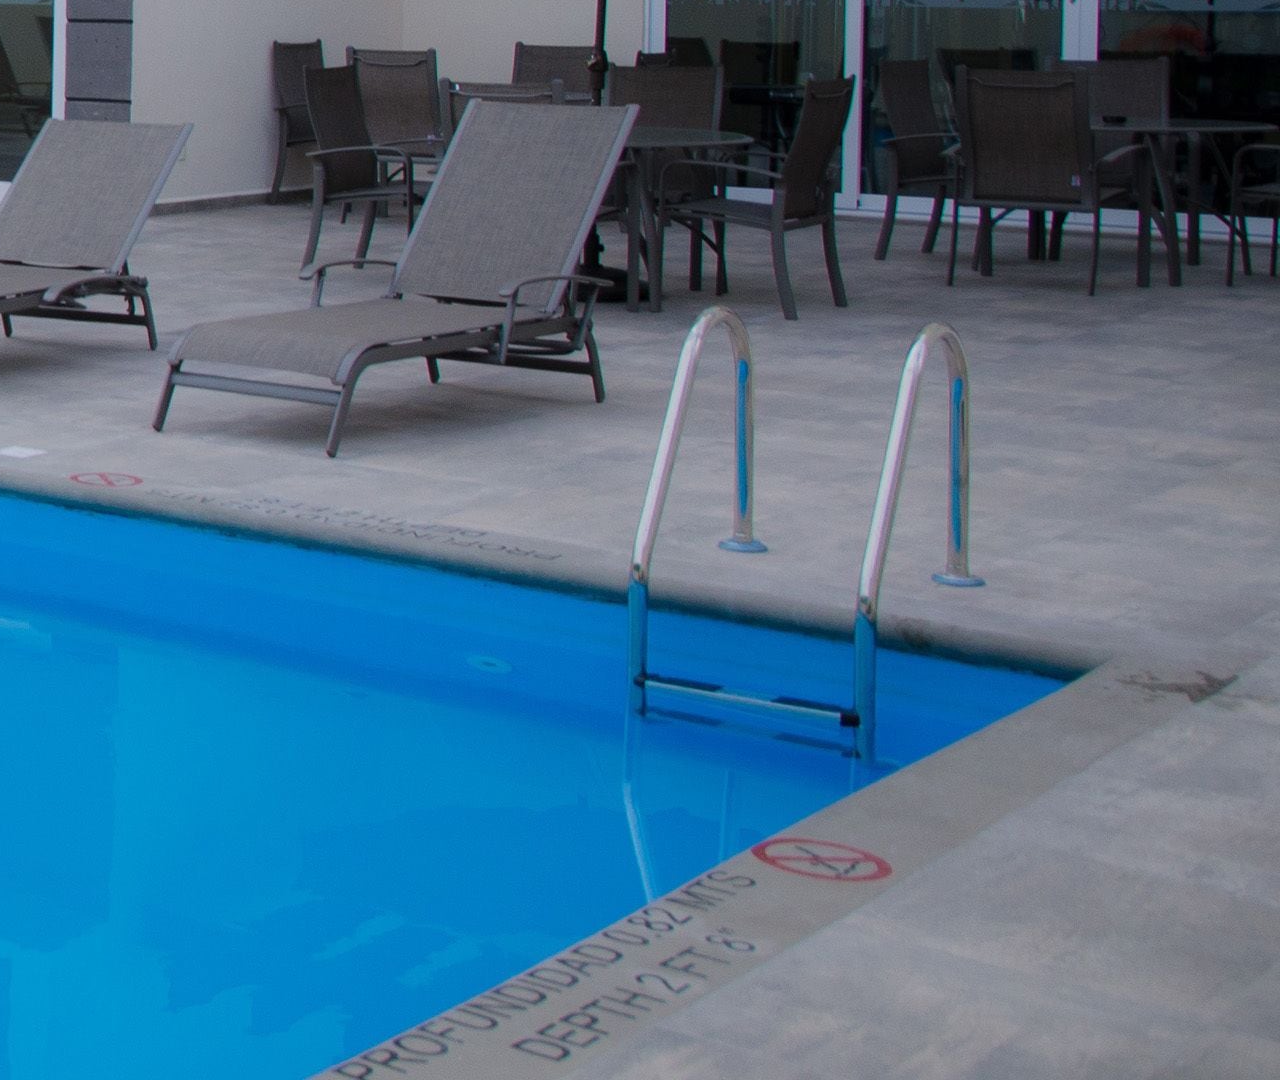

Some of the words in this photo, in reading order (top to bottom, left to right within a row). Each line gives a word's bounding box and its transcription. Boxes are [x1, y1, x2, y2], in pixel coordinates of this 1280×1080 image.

[334, 942, 624, 1080] PROFUNDIDAD
[602, 906, 694, 946] 0.82
[664, 870, 757, 912] MTS
[635, 973, 691, 994] 2
[658, 946, 733, 980] FT
[510, 986, 668, 1062] DEPTH
